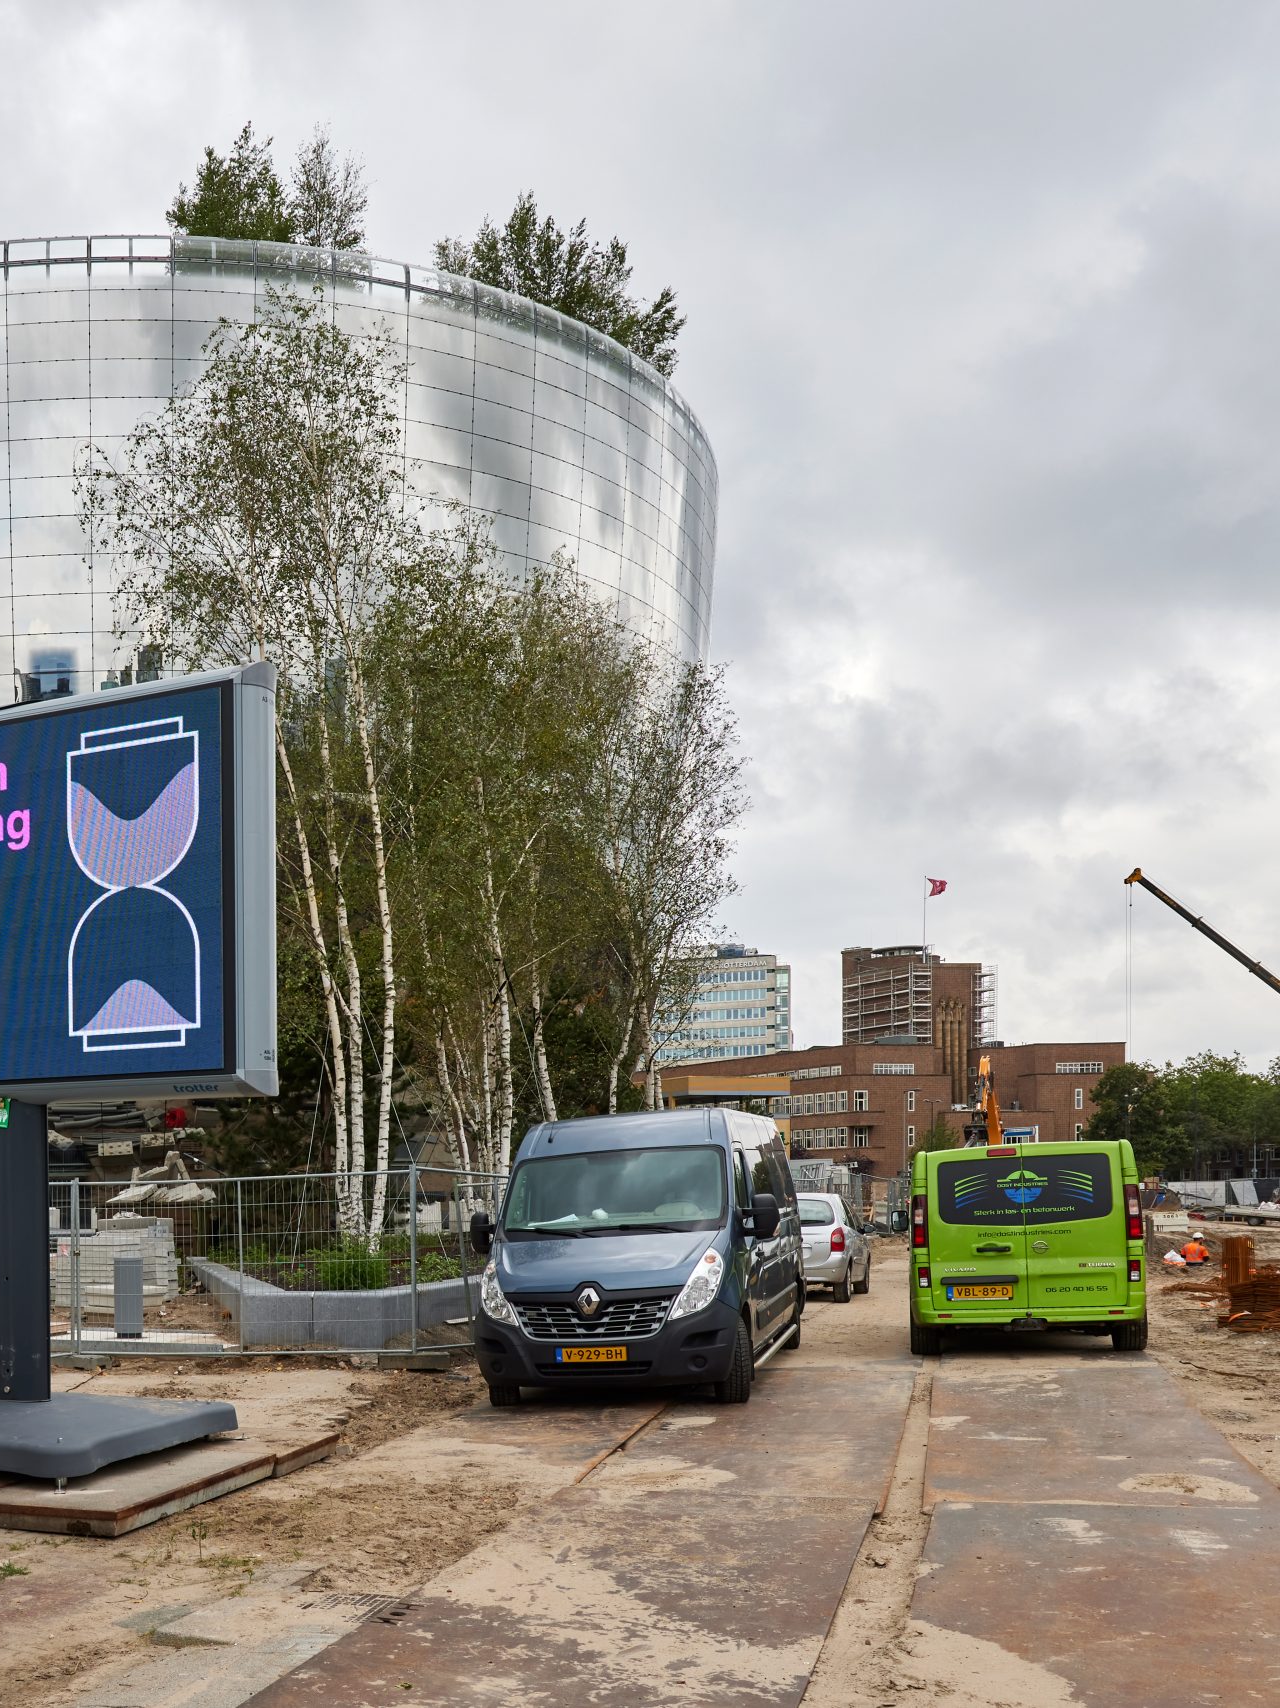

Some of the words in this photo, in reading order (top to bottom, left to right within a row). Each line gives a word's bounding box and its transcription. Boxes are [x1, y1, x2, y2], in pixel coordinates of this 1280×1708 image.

[173, 1084, 219, 1093] trotter
[957, 1287, 1009, 1296] VBL-89-D
[565, 1349, 623, 1360] V-929-BH
